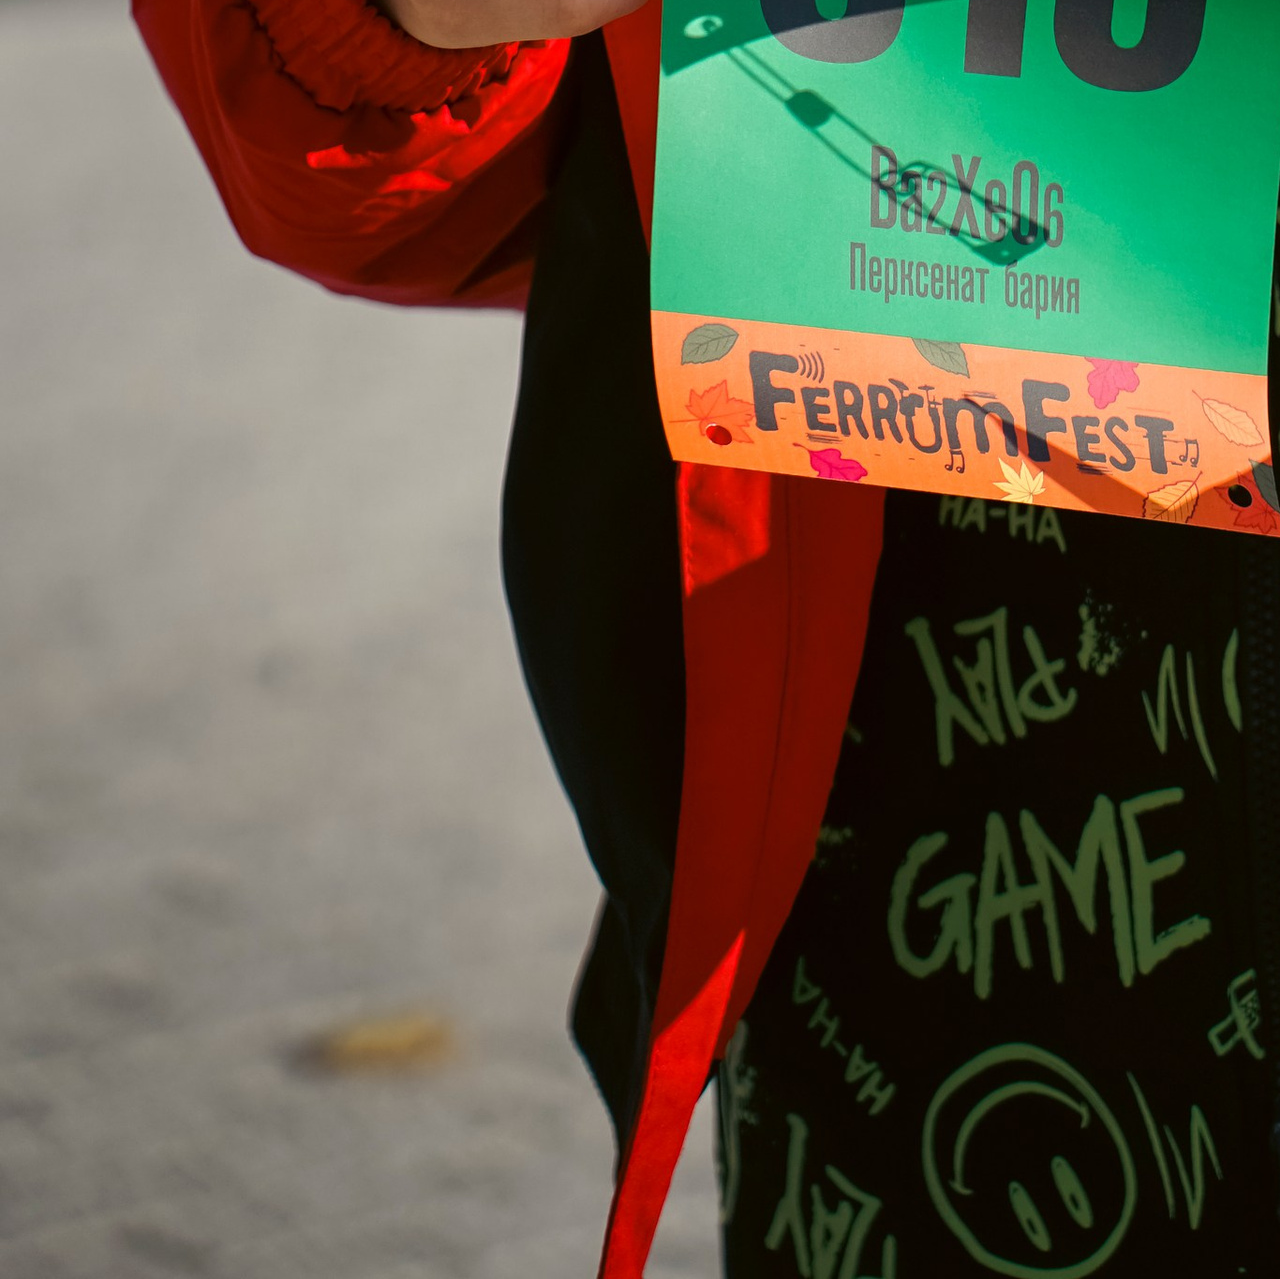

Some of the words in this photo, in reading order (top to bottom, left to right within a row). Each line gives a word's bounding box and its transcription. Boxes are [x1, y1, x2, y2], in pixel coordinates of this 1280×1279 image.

[850, 241, 990, 304] Перксенат
[1004, 259, 1080, 320] бария
[904, 606, 1077, 767] PLAY
[888, 788, 1212, 1001] GAME
